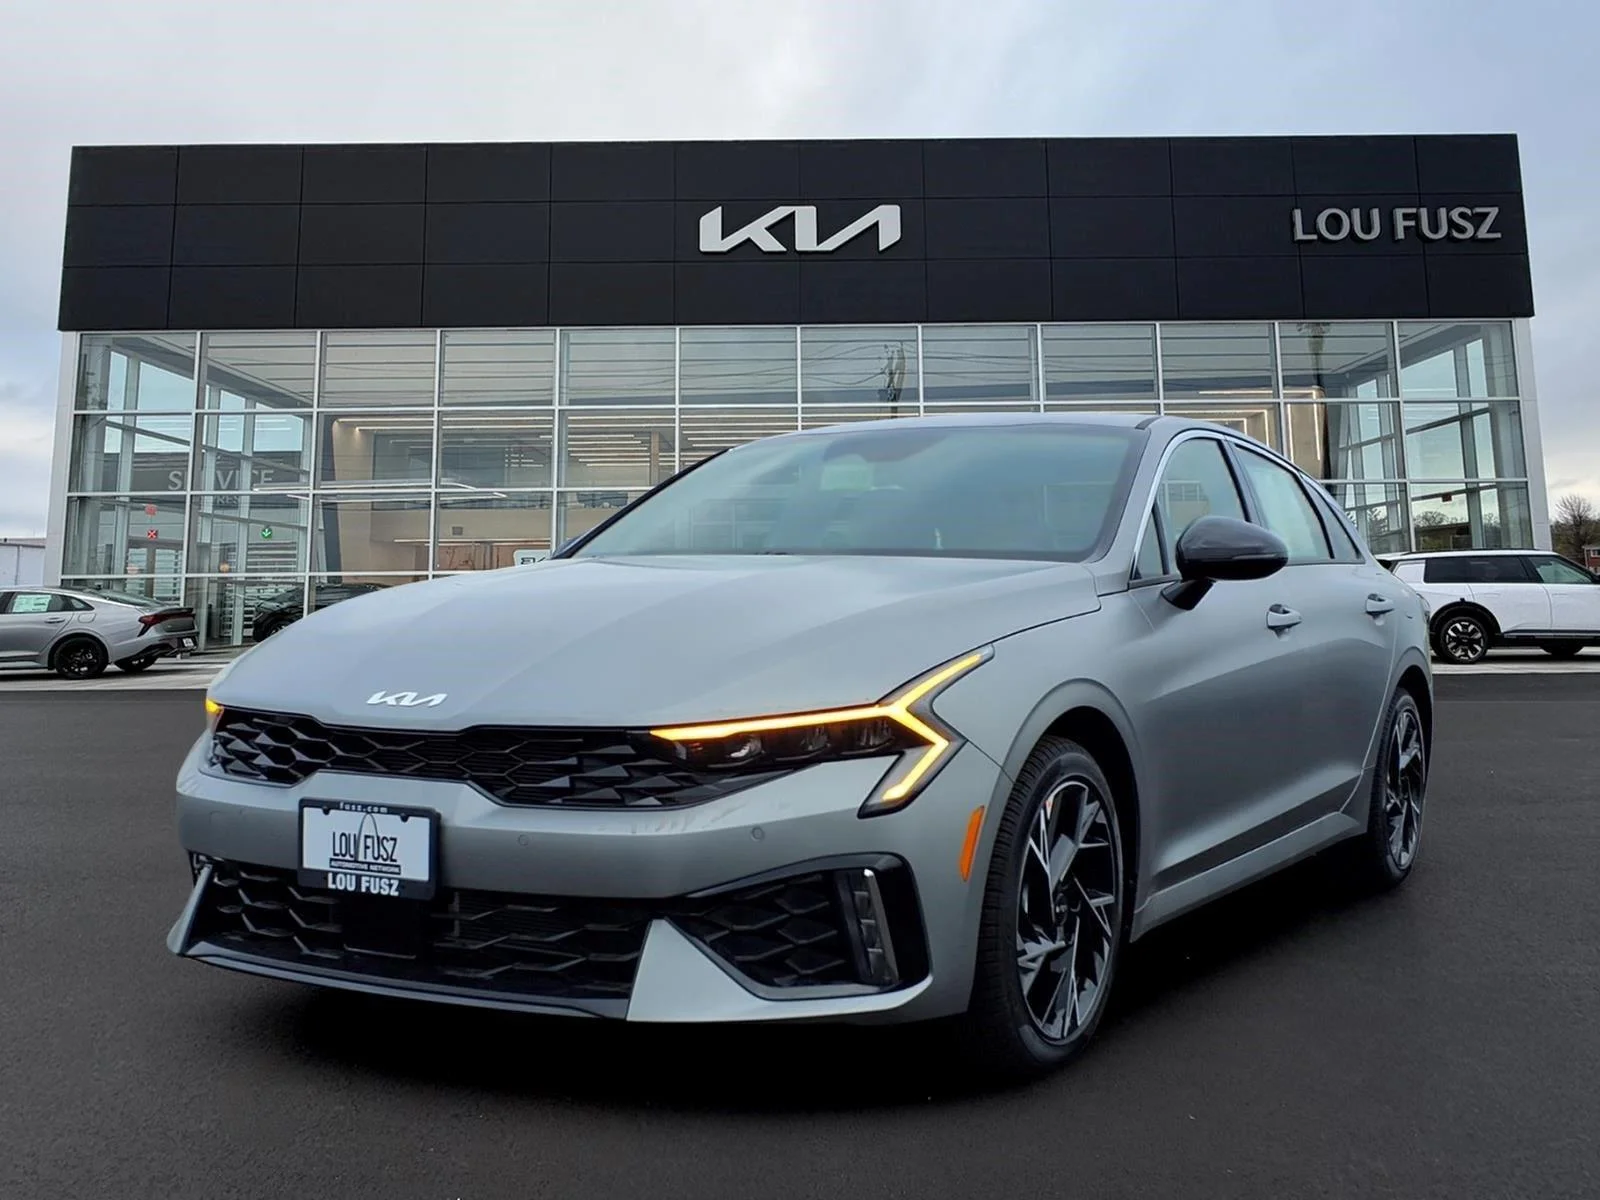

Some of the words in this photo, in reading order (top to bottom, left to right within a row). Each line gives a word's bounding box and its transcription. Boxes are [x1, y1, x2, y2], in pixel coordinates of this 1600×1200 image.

[699, 204, 901, 252] KIA
[1293, 208, 1381, 241] LOU
[1393, 206, 1502, 240] FUSZ
[168, 469, 274, 490] SVIE
[366, 690, 448, 707] KIA
[339, 801, 388, 813] fusz.com
[332, 831, 357, 858] LOU
[364, 834, 398, 862] FUSZ
[328, 872, 356, 891] LOU
[361, 876, 399, 896] FUSZ
